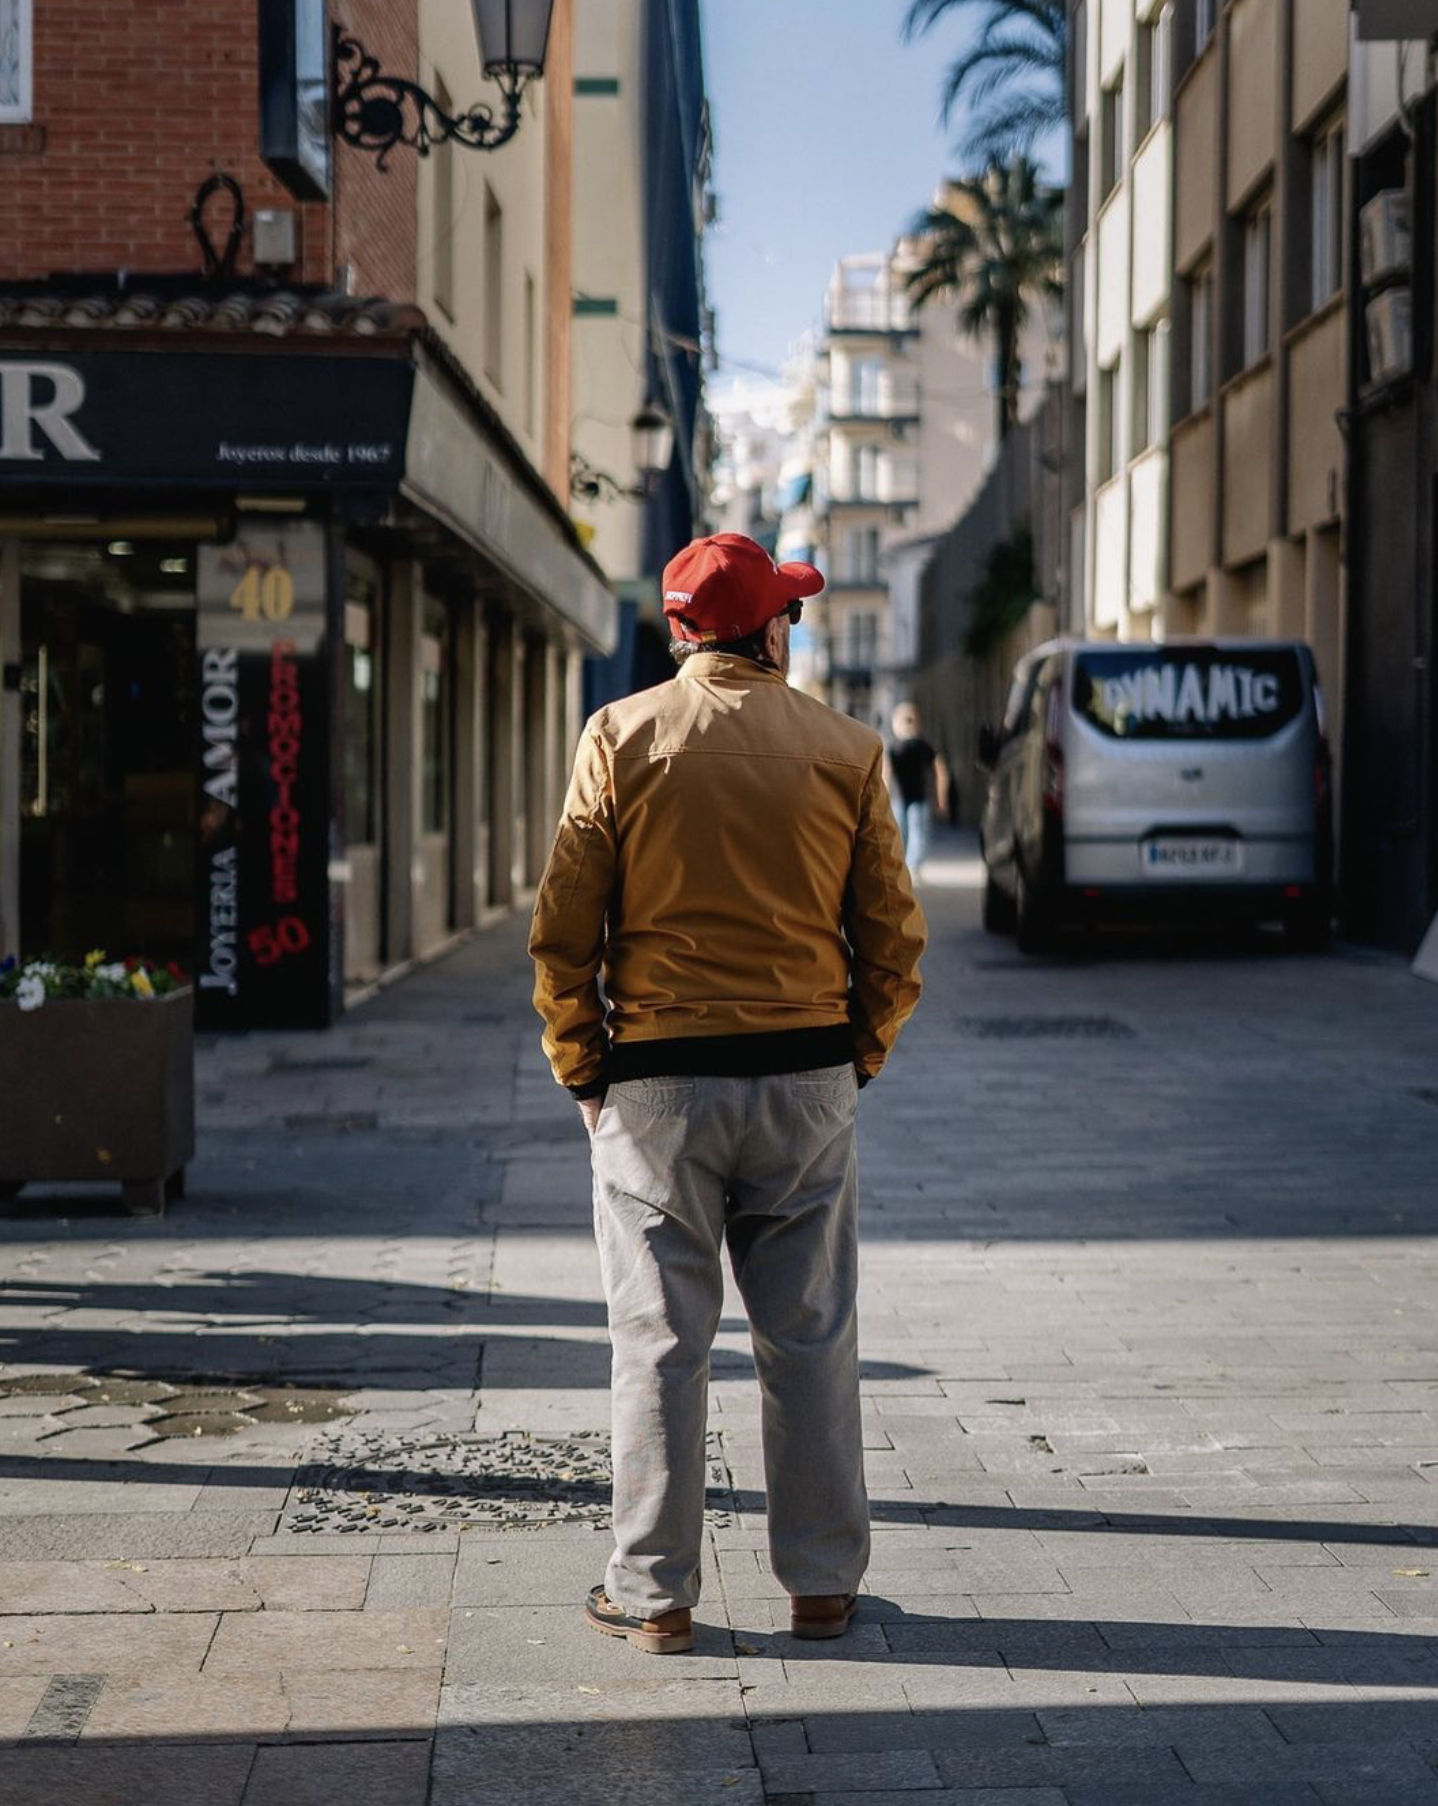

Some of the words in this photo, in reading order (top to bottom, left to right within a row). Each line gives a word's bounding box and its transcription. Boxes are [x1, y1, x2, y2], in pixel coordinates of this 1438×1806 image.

[0, 361, 101, 461] R
[216, 441, 282, 465] Joyeros
[286, 441, 341, 462] desde
[230, 564, 294, 624] 40
[1103, 663, 1279, 723] DYNAMIC
[203, 645, 239, 807] AMOR
[248, 916, 310, 965] 50
